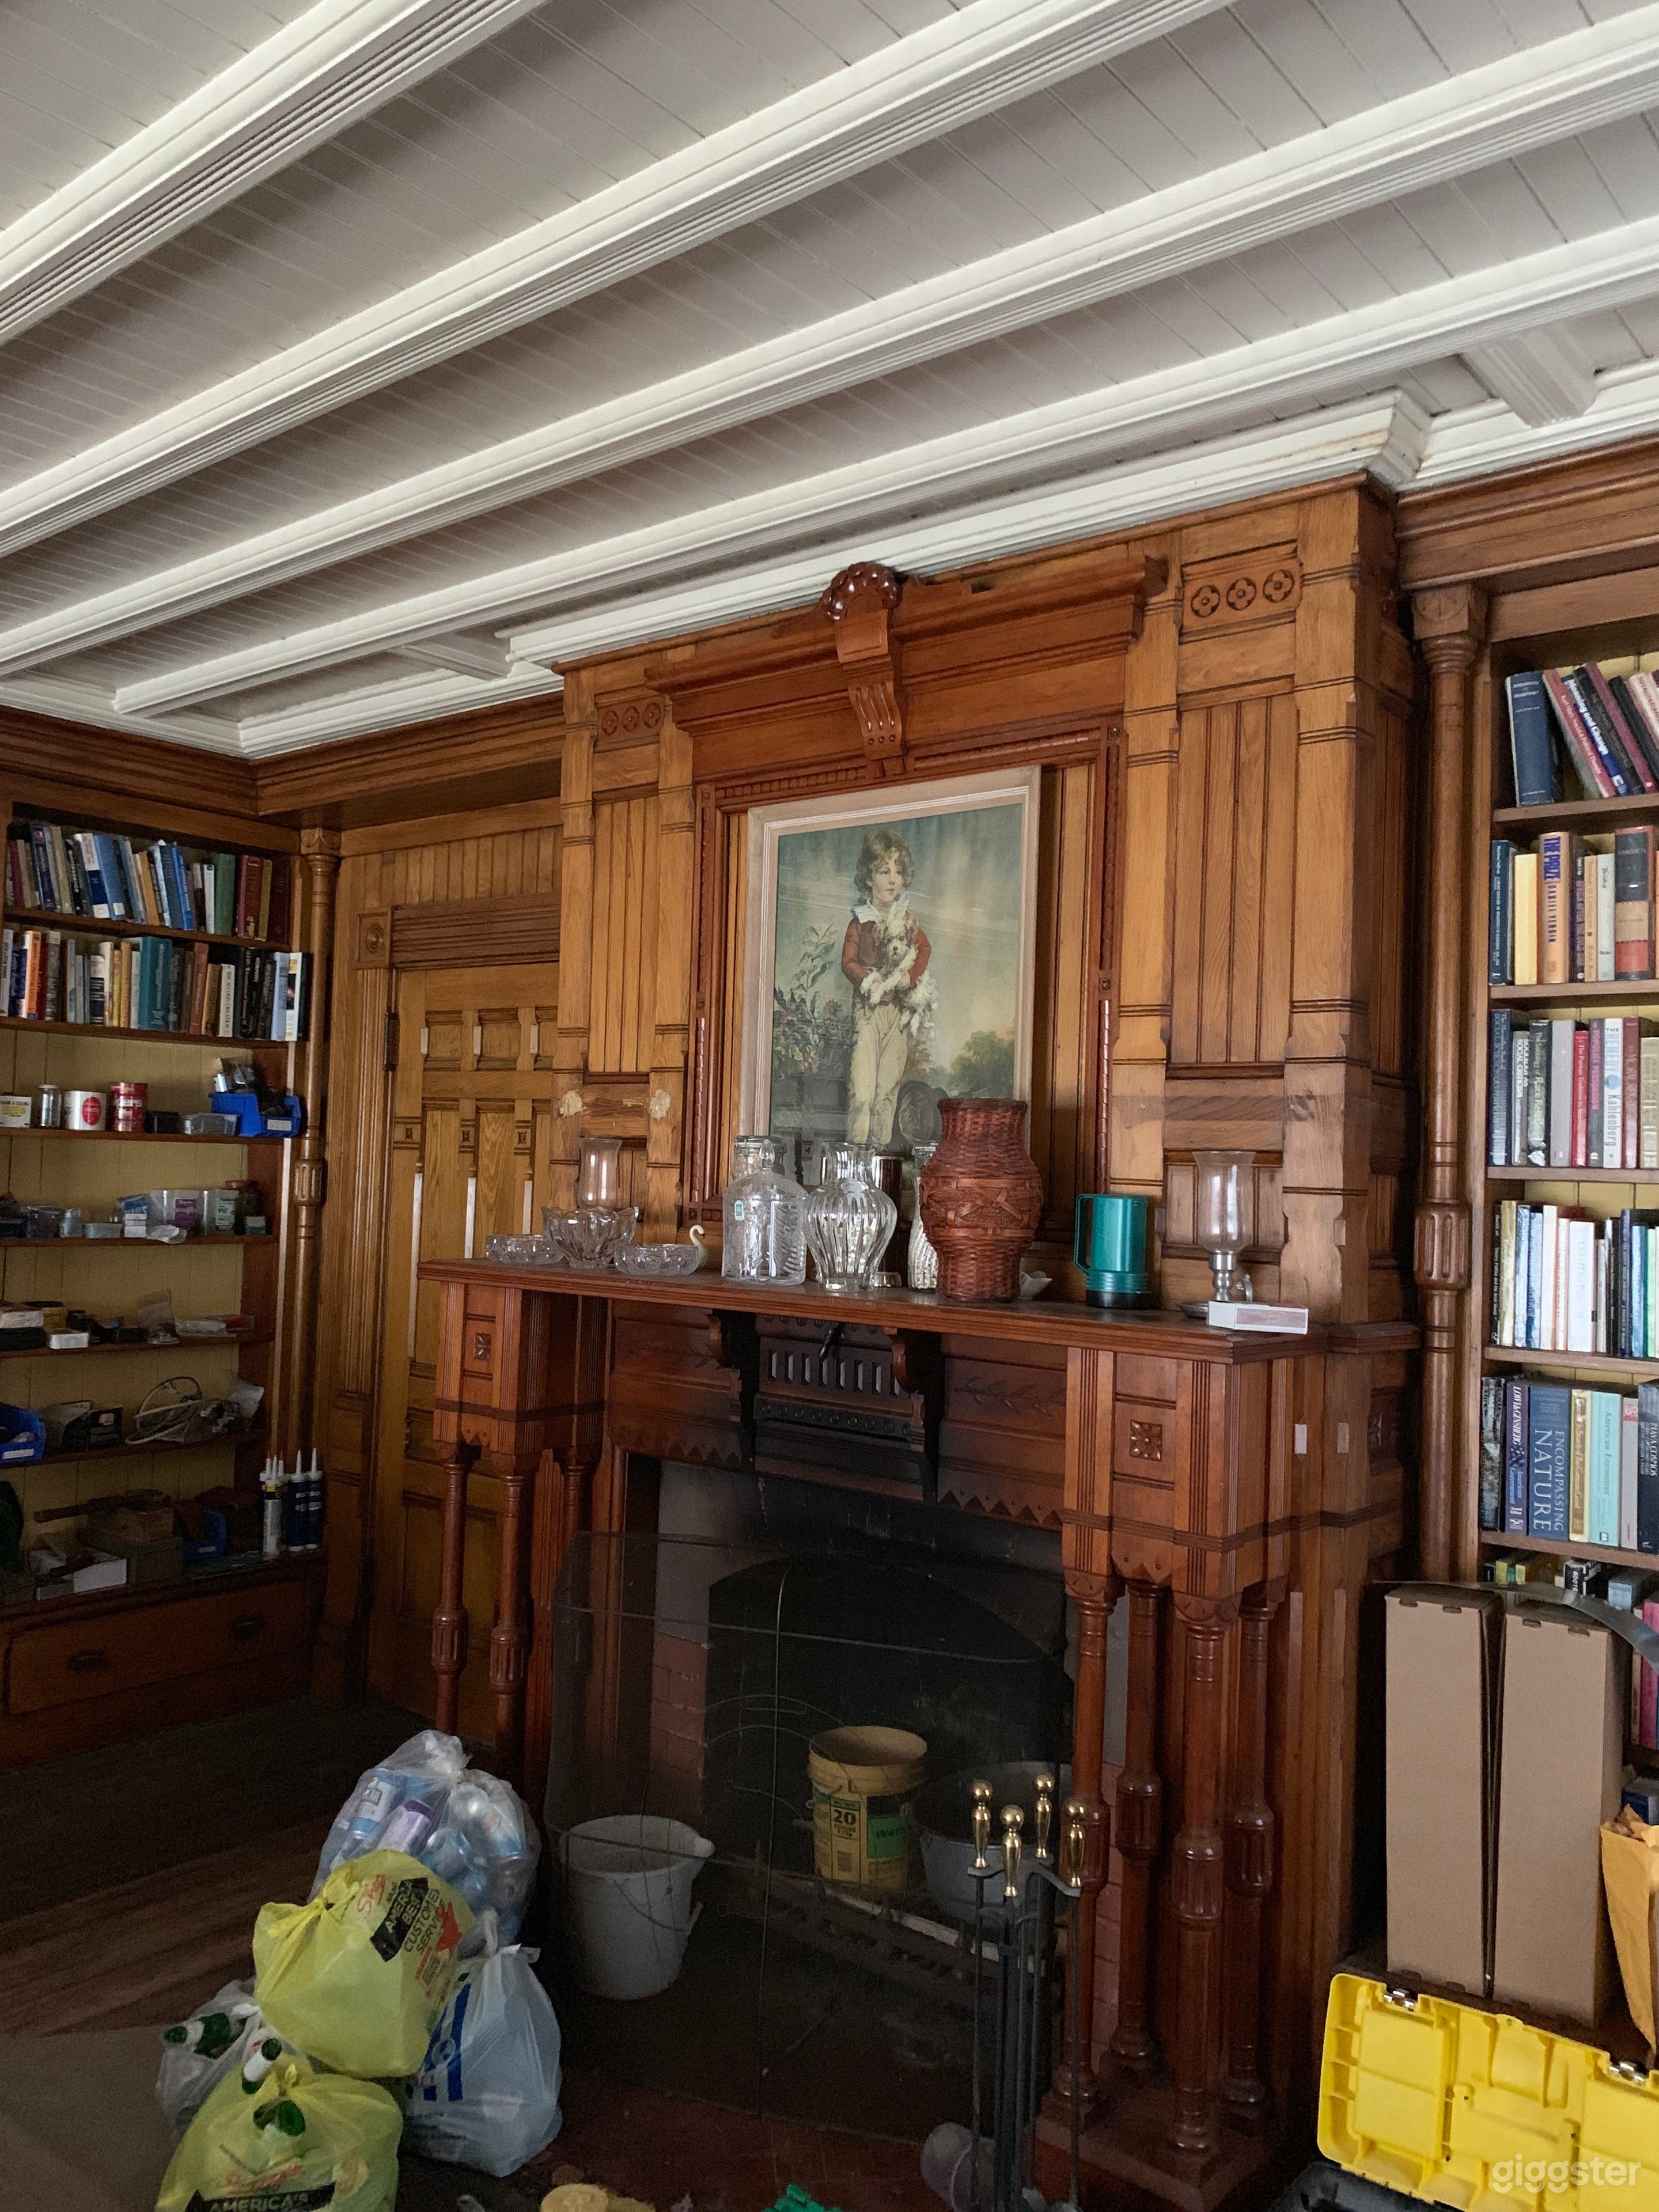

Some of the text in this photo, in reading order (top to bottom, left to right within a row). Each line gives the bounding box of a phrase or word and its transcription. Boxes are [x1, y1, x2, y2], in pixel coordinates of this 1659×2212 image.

[1544, 836, 1560, 881] THE PRIZE
[1548, 885, 1557, 943] DANIEL YERGIN
[1534, 1042, 1542, 1069] Sociology
[1605, 1033, 1619, 1073] REMEDY
[1534, 1076, 1544, 1099] Race
[1533, 1099, 1544, 1139] Relations
[1604, 1094, 1621, 1146] Kahlenberg
[1603, 1411, 1613, 1496] American Encounter
[1533, 1429, 1552, 1531] NATURE
[1554, 1431, 1565, 1532] ENCOMPASSING
[834, 1809, 857, 1825] 20
[404, 1889, 442, 1953] CUSTOME
